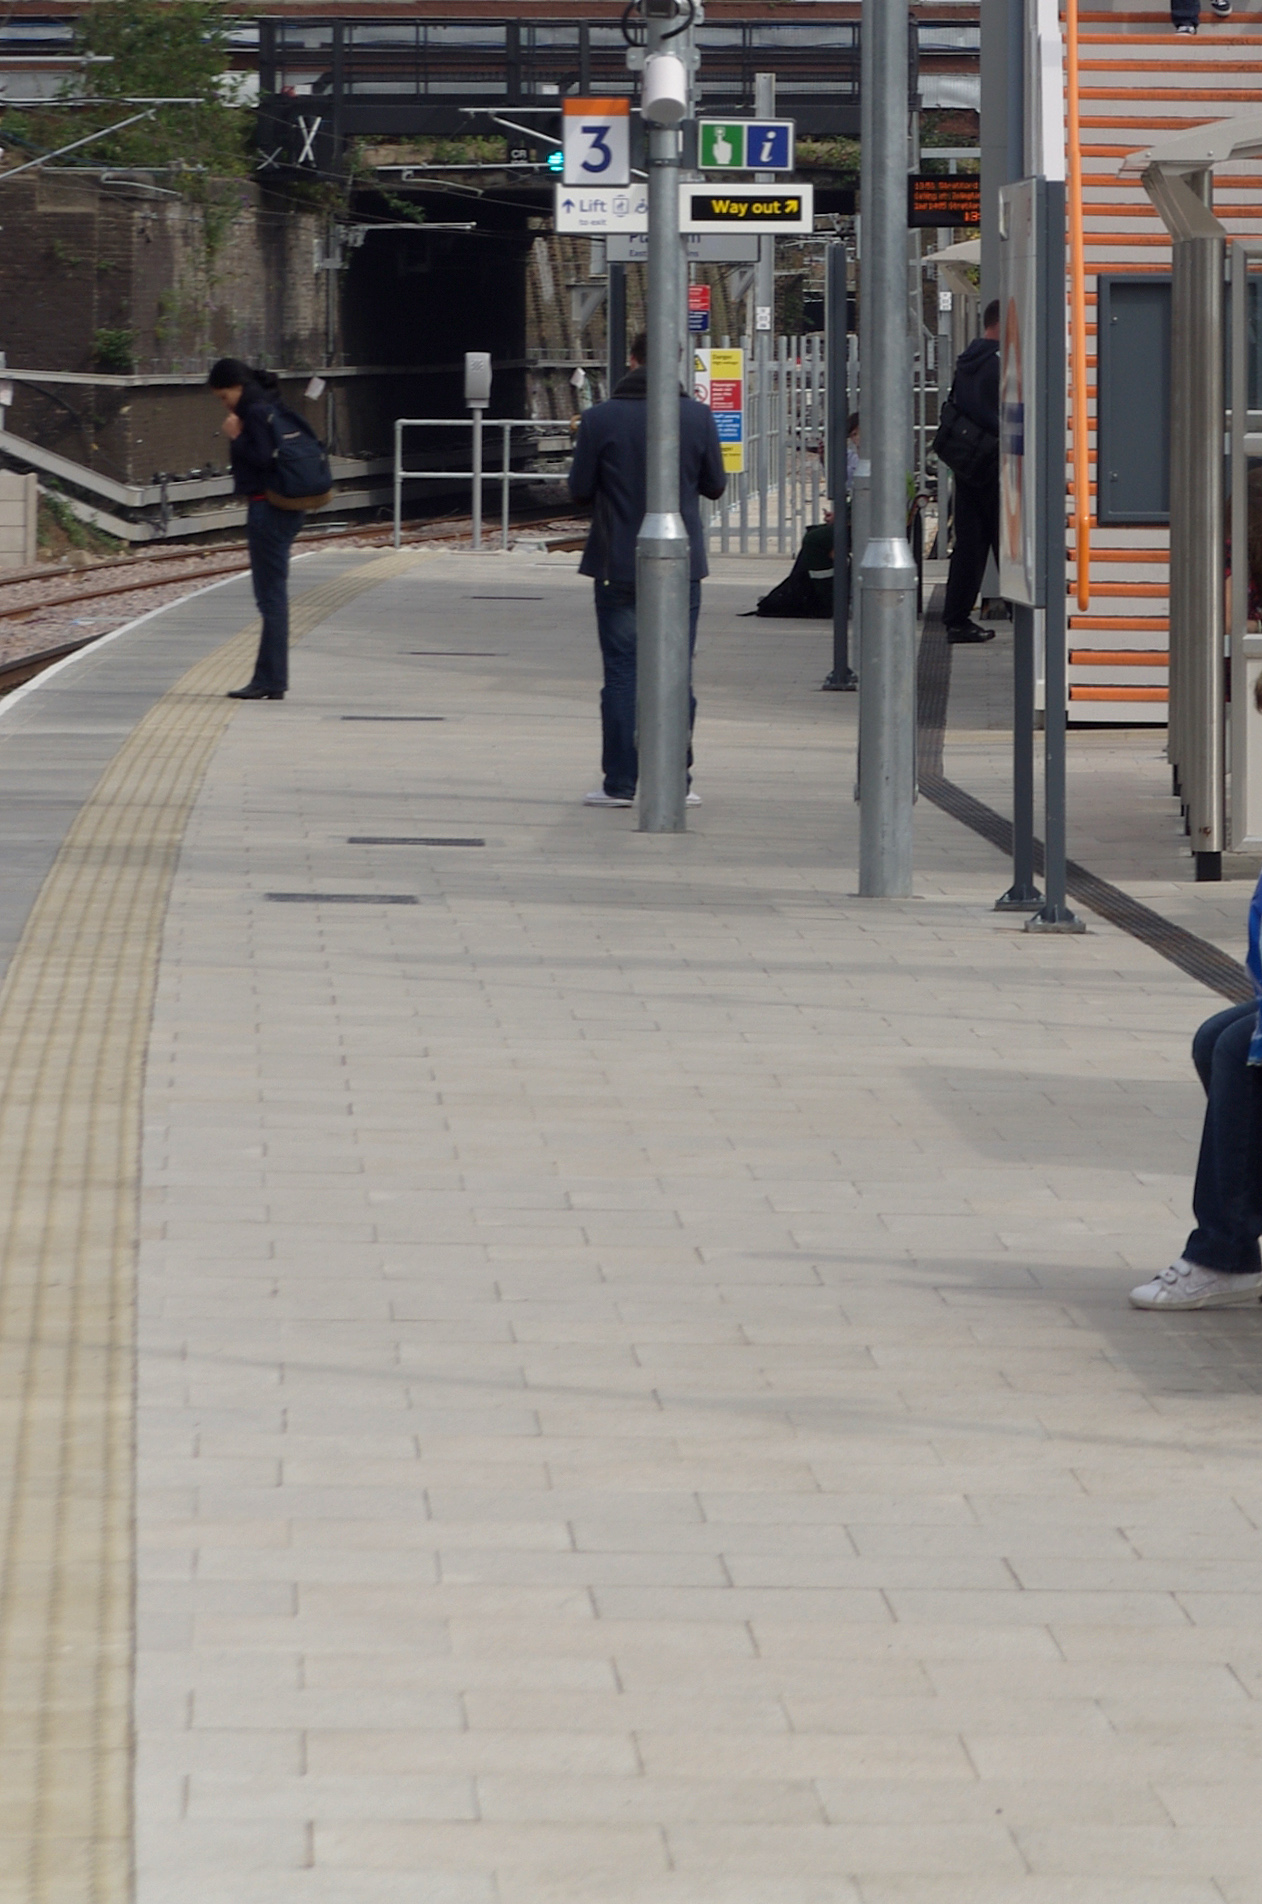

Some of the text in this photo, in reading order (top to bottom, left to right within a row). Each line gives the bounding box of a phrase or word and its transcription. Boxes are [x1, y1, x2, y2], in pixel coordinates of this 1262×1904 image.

[580, 125, 613, 174] 3
[579, 199, 608, 213] Lift
[711, 199, 782, 217] Way out
